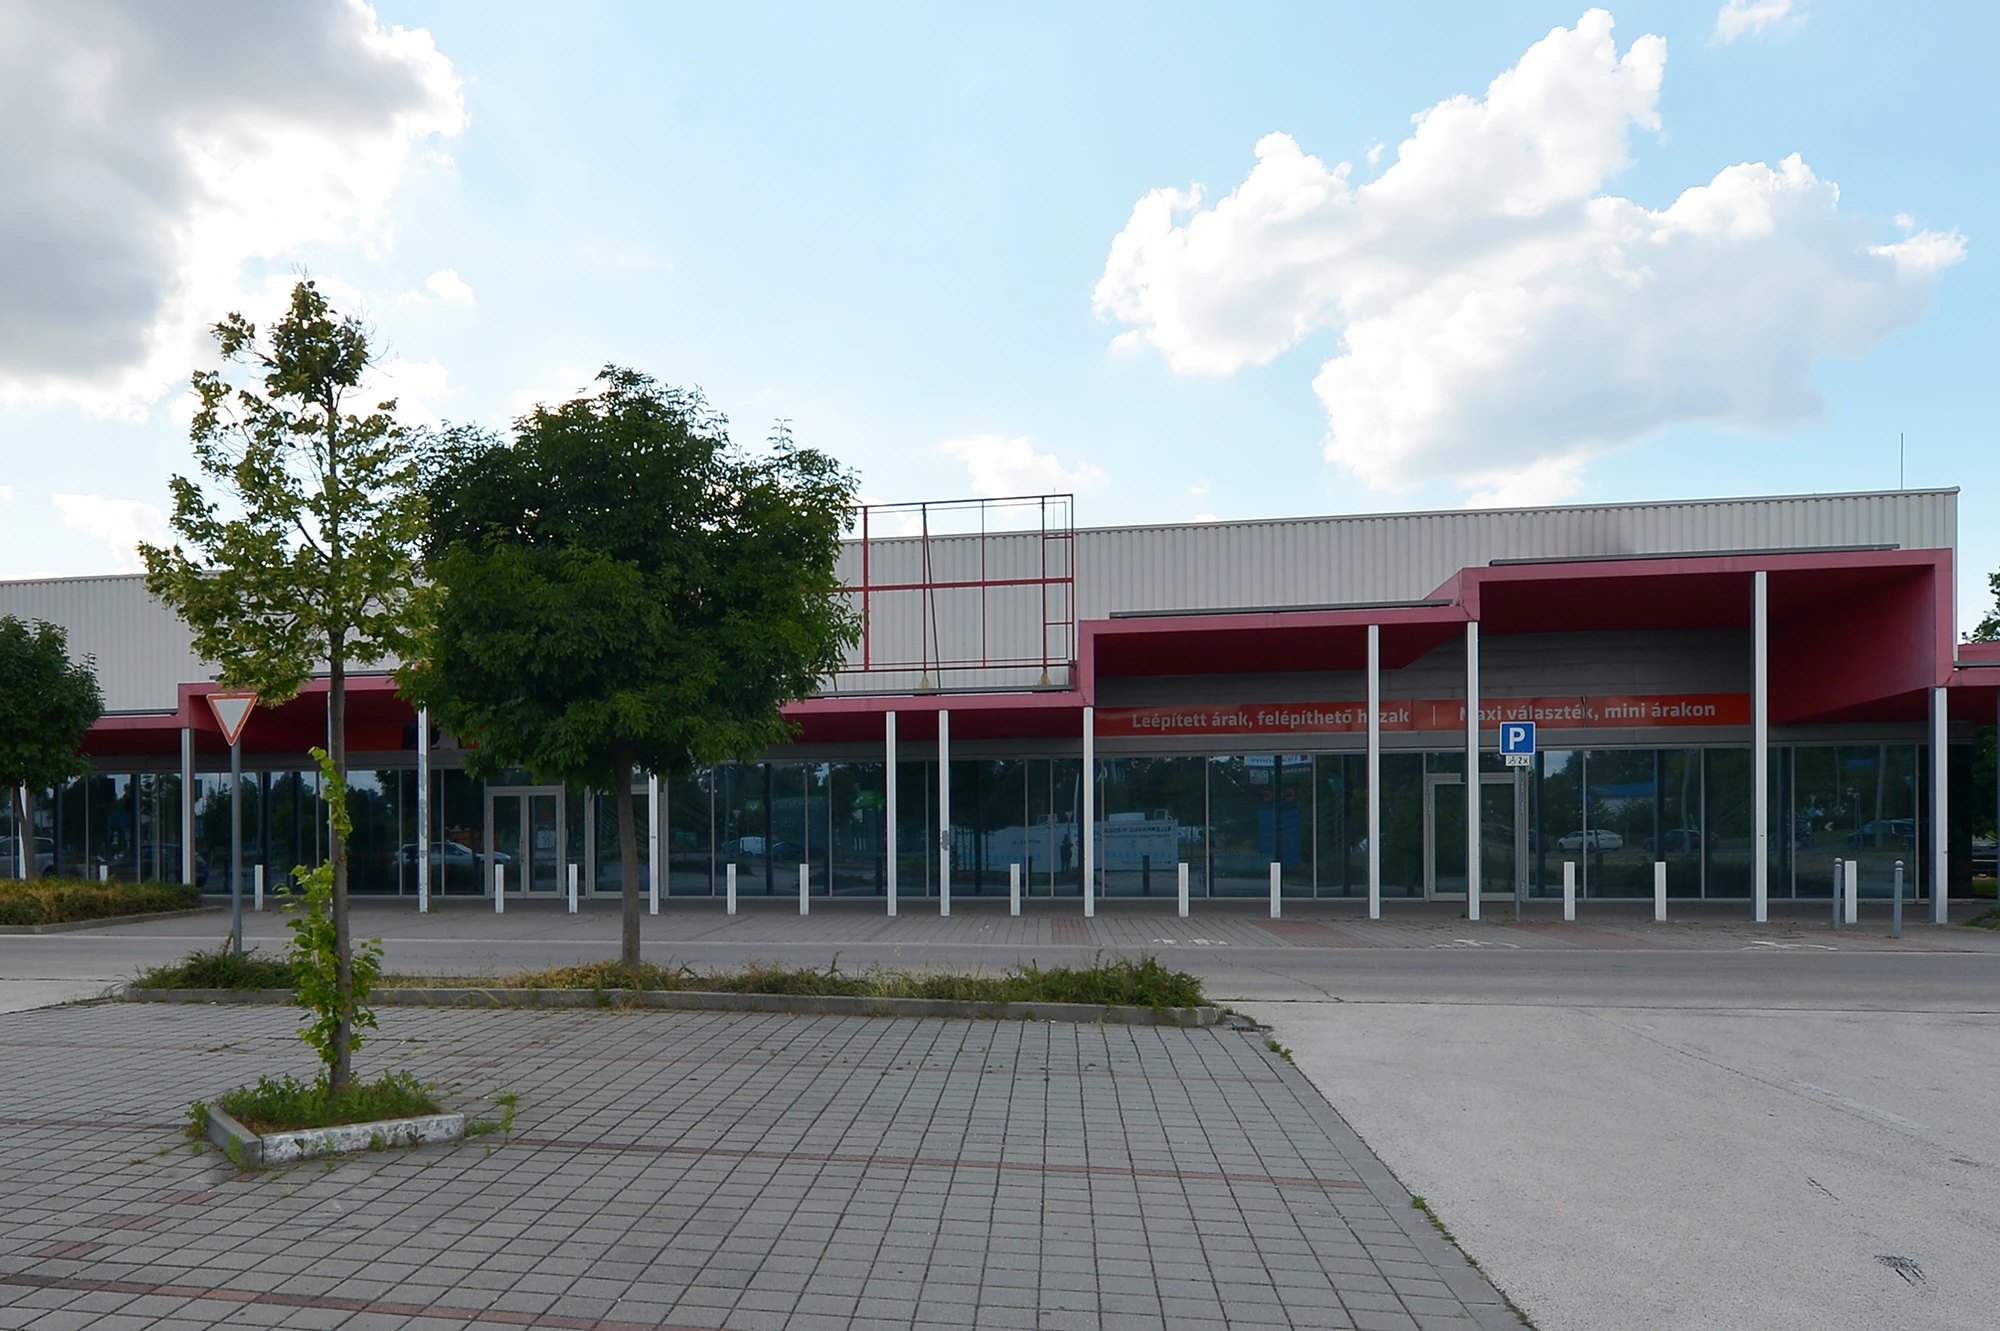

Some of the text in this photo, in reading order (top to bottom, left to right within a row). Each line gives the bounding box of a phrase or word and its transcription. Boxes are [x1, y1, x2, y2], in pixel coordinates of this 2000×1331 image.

[1132, 708, 1409, 730] Leépített árak, felépíthető hzak
[1507, 705, 1599, 722] választék,
[1604, 702, 1646, 719] mini
[1651, 701, 1715, 718] árakon
[1509, 727, 1526, 750] P
[1518, 756, 1528, 765] 2x
